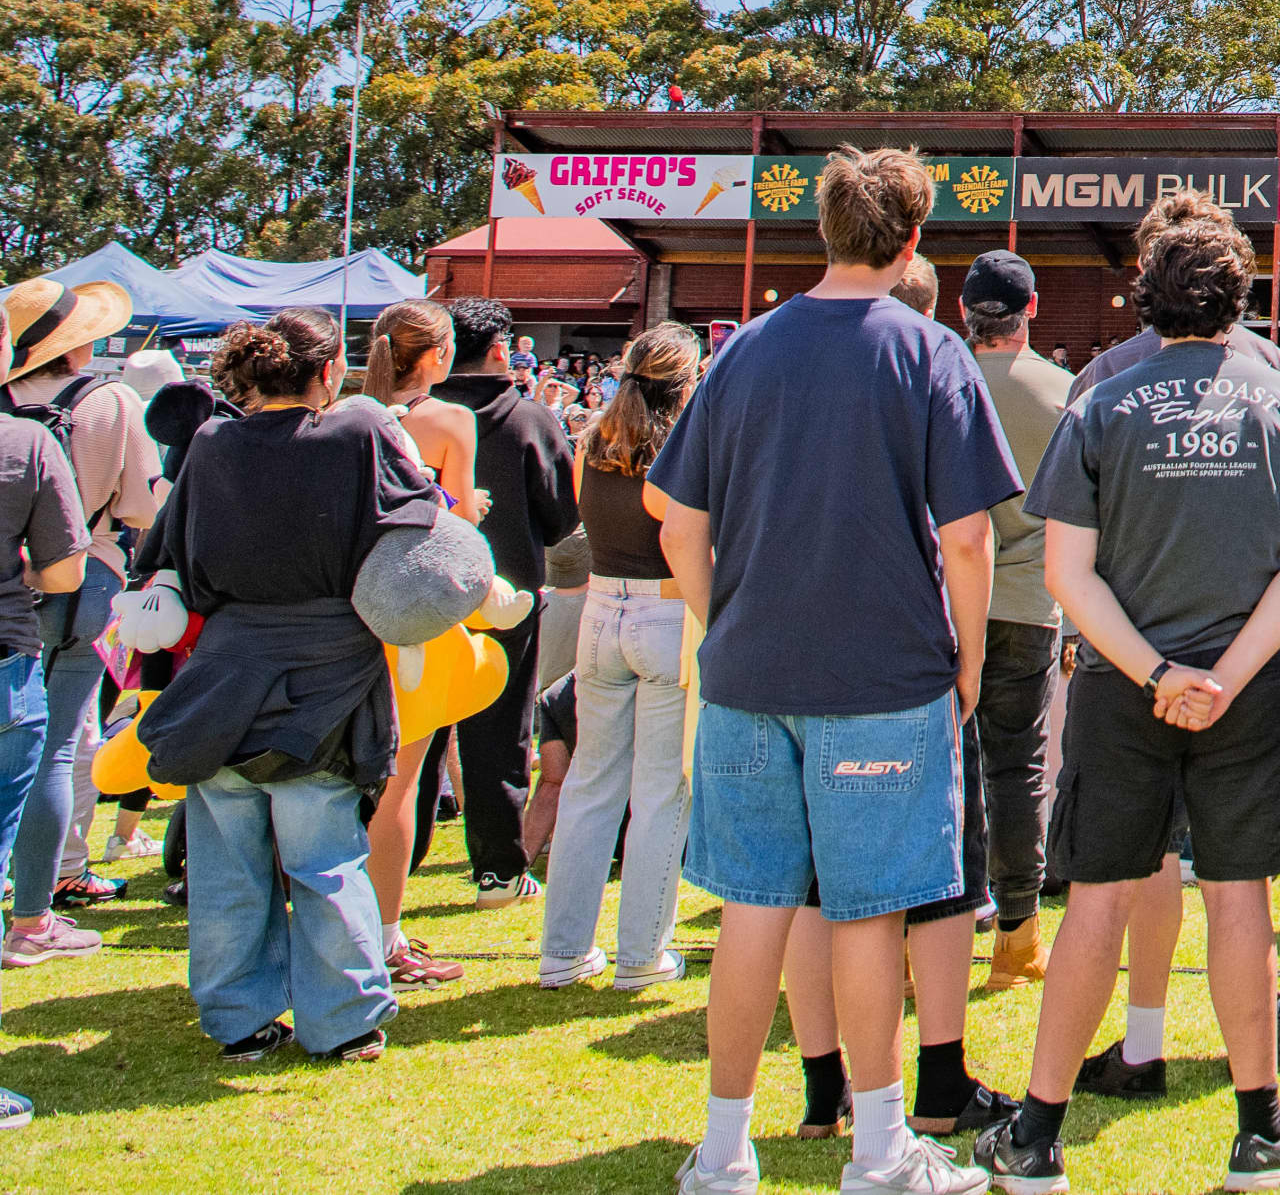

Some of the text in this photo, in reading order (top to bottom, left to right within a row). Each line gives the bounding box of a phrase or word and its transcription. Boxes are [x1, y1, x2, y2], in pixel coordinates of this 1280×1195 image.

[550, 157, 696, 186] GRIFFO'S
[754, 180, 790, 191] TREENDALE
[953, 179, 1008, 192] TREENDALE FARM
[1021, 173, 1144, 207] MGM
[575, 187, 666, 216] SOFT SERVE
[1112, 378, 1187, 415] WEST
[1150, 395, 1249, 433] Eagles
[1165, 431, 1239, 457] 1986
[1142, 461, 1257, 472] AUSTRALIAN FOOTBALL LEAGUE
[1155, 469, 1246, 478] AUTHENTIC SPORT DEPT.
[834, 760, 913, 775] RUSTY
